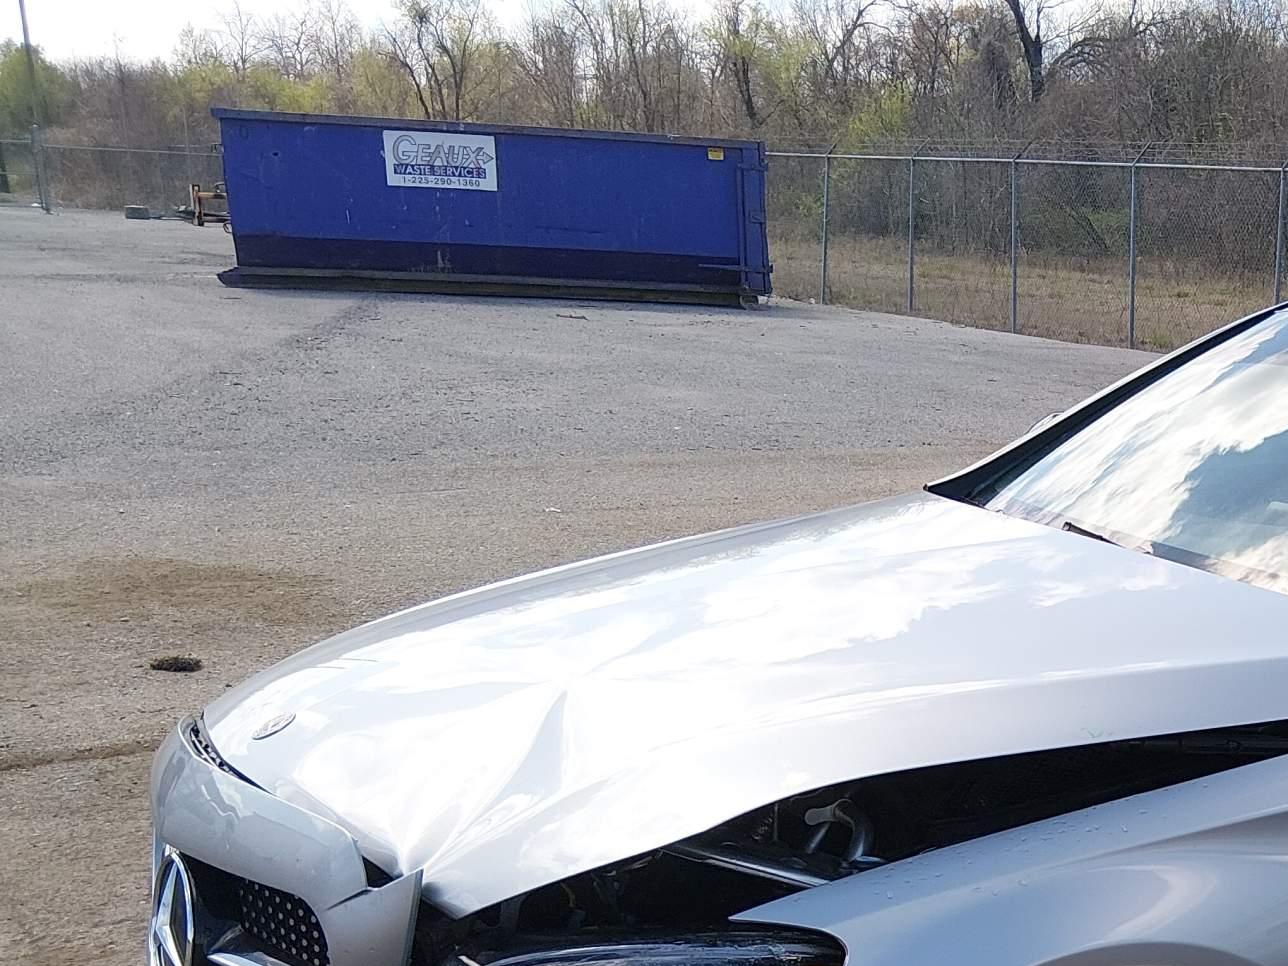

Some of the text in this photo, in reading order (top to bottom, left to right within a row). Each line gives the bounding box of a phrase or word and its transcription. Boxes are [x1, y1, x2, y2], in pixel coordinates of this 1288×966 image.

[393, 134, 484, 169] GEAUX
[394, 165, 486, 178] WASTE SERVICES
[402, 177, 480, 187] 1-225-290-1360
